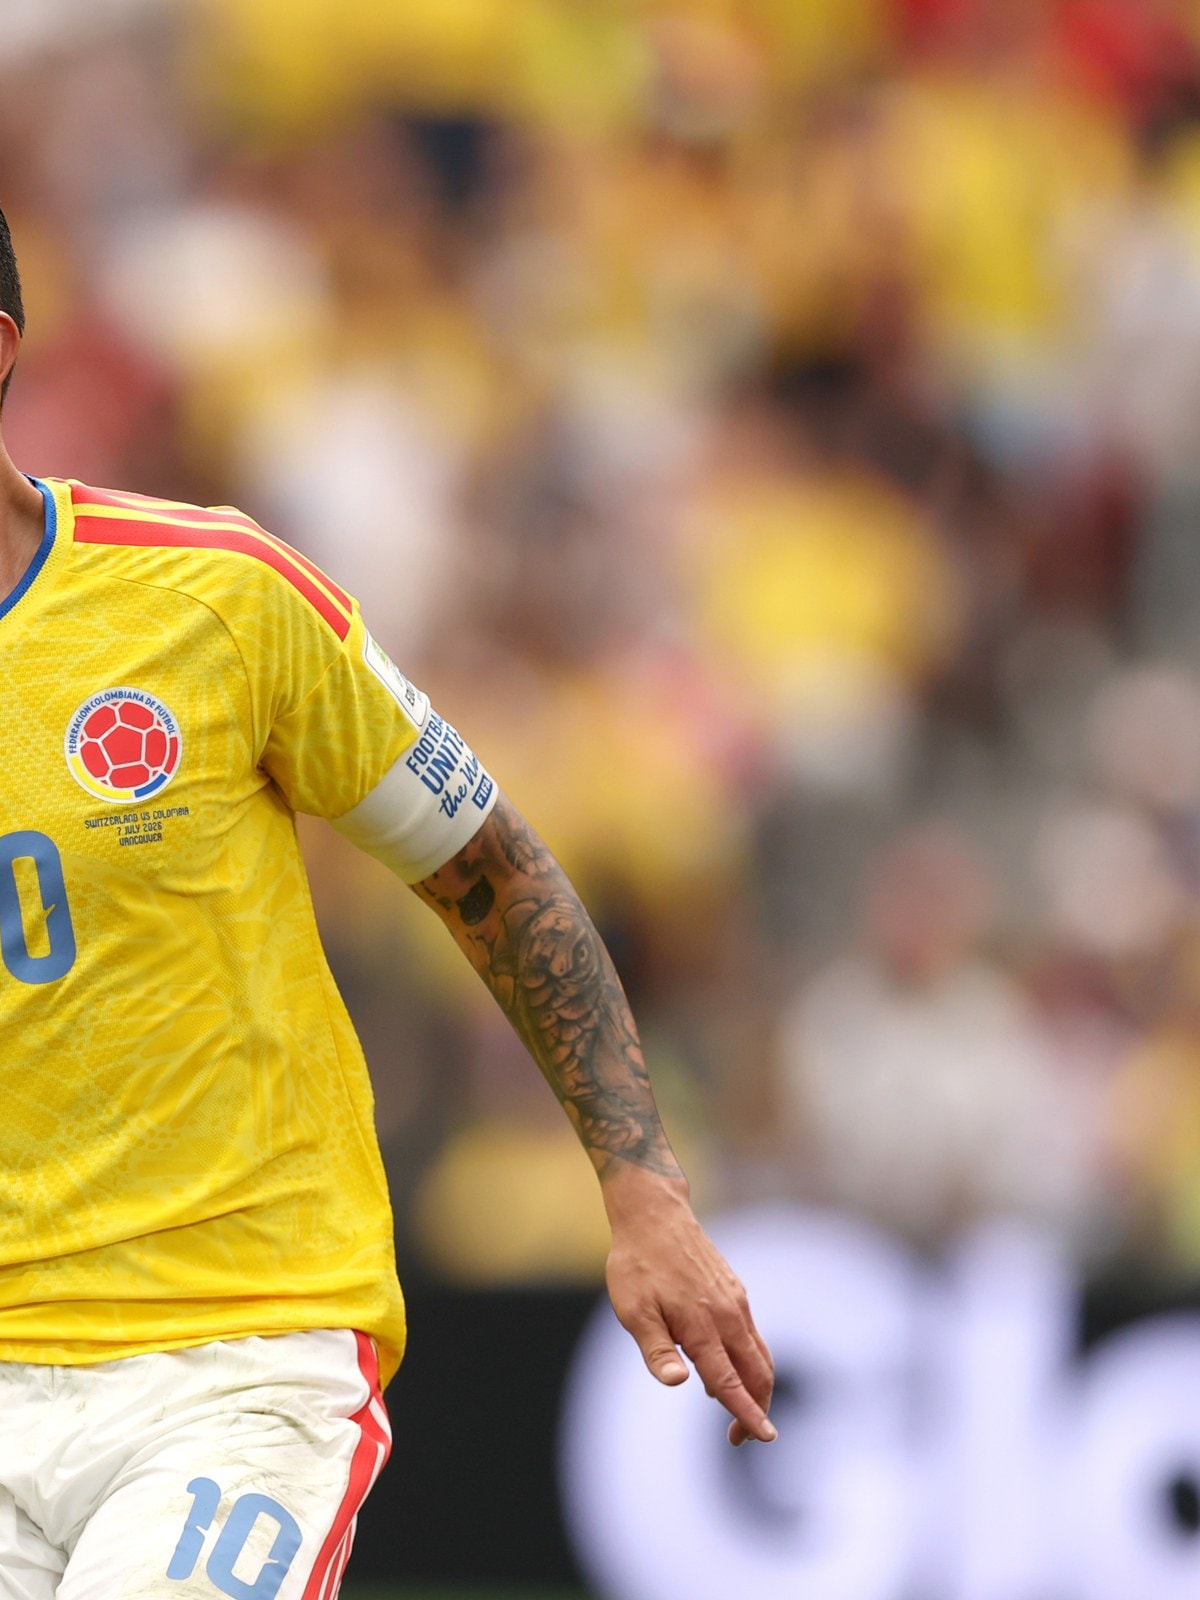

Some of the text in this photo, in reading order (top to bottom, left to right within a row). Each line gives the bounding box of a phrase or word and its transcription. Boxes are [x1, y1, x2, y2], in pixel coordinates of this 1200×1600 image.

[90, 690, 144, 708] COLOMBIANA
[145, 697, 156, 708] DE
[439, 784, 467, 818] the
[474, 775, 492, 805] FIFA
[84, 806, 190, 829] SWITZERLAND VS COLOMBIA
[117, 822, 162, 836] 7 JULY 2026
[119, 832, 163, 847] VANCOUVER
[166, 1476, 303, 1600] 10
